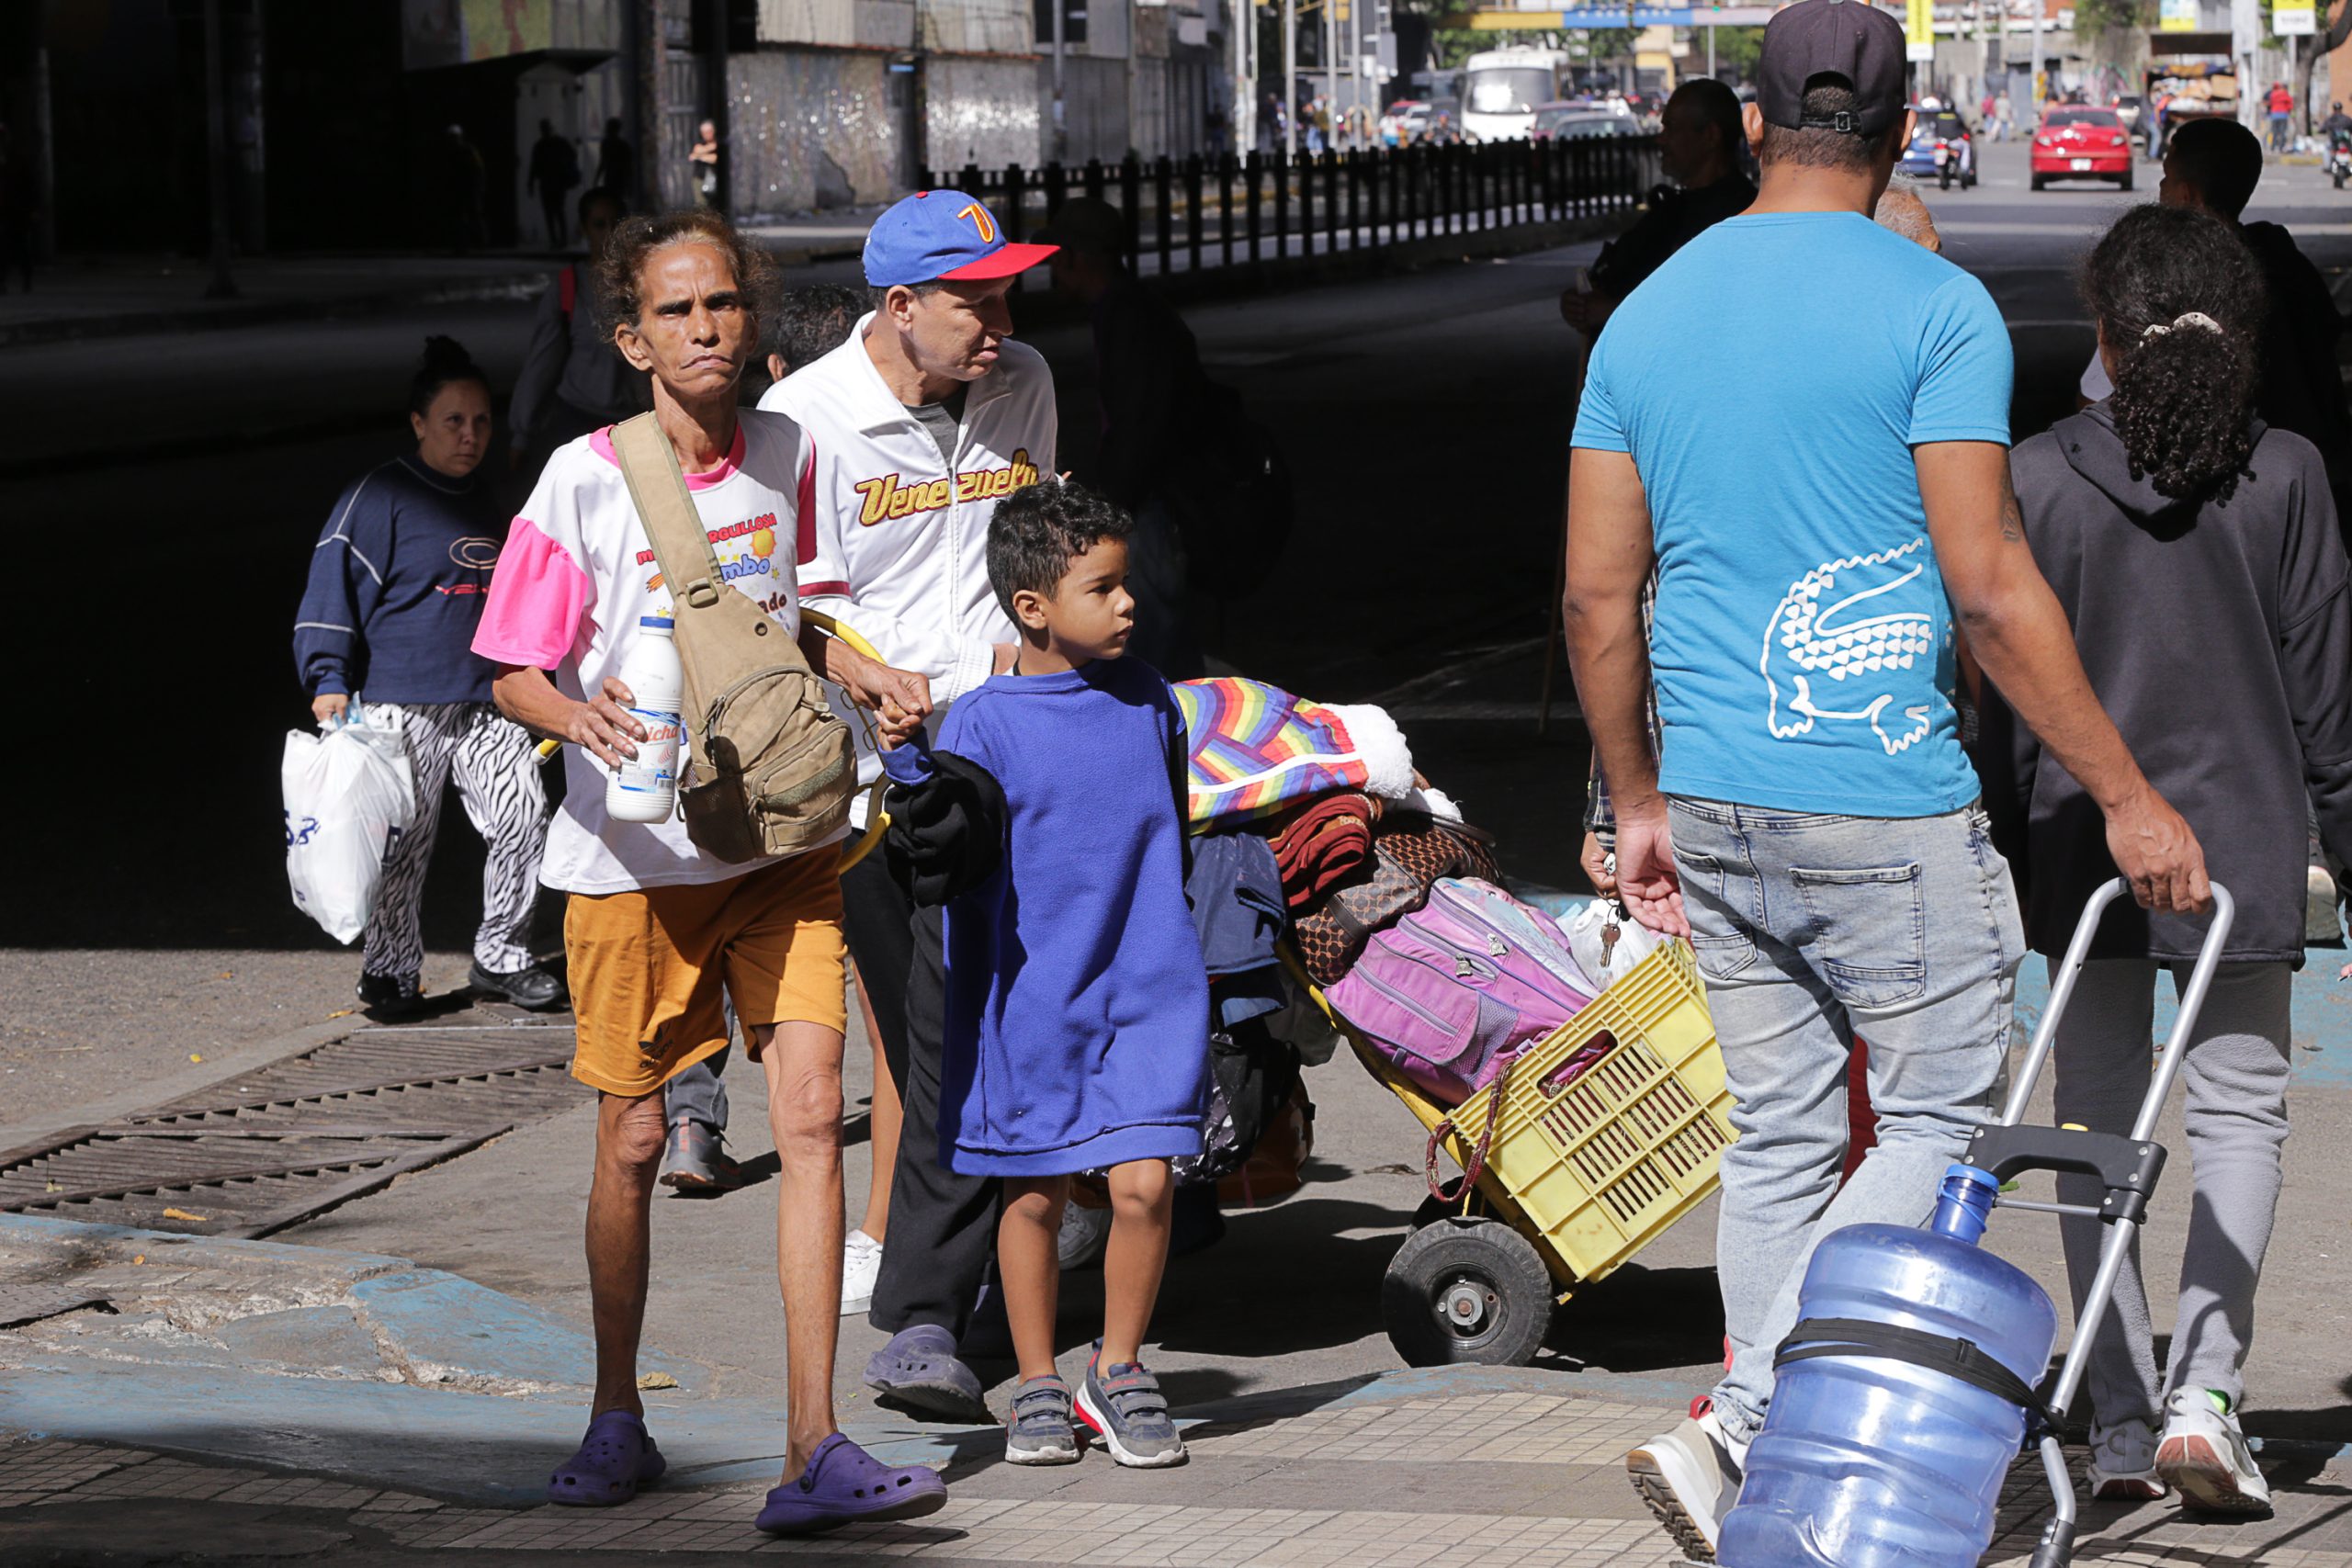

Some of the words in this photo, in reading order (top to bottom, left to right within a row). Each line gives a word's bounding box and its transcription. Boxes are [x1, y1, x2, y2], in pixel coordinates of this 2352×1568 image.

[854, 447, 1039, 526] Venezuela
[707, 513, 777, 544] RGULLOSA
[720, 554, 770, 581] mbo
[757, 592, 787, 614] ado
[647, 725, 679, 741] icha
